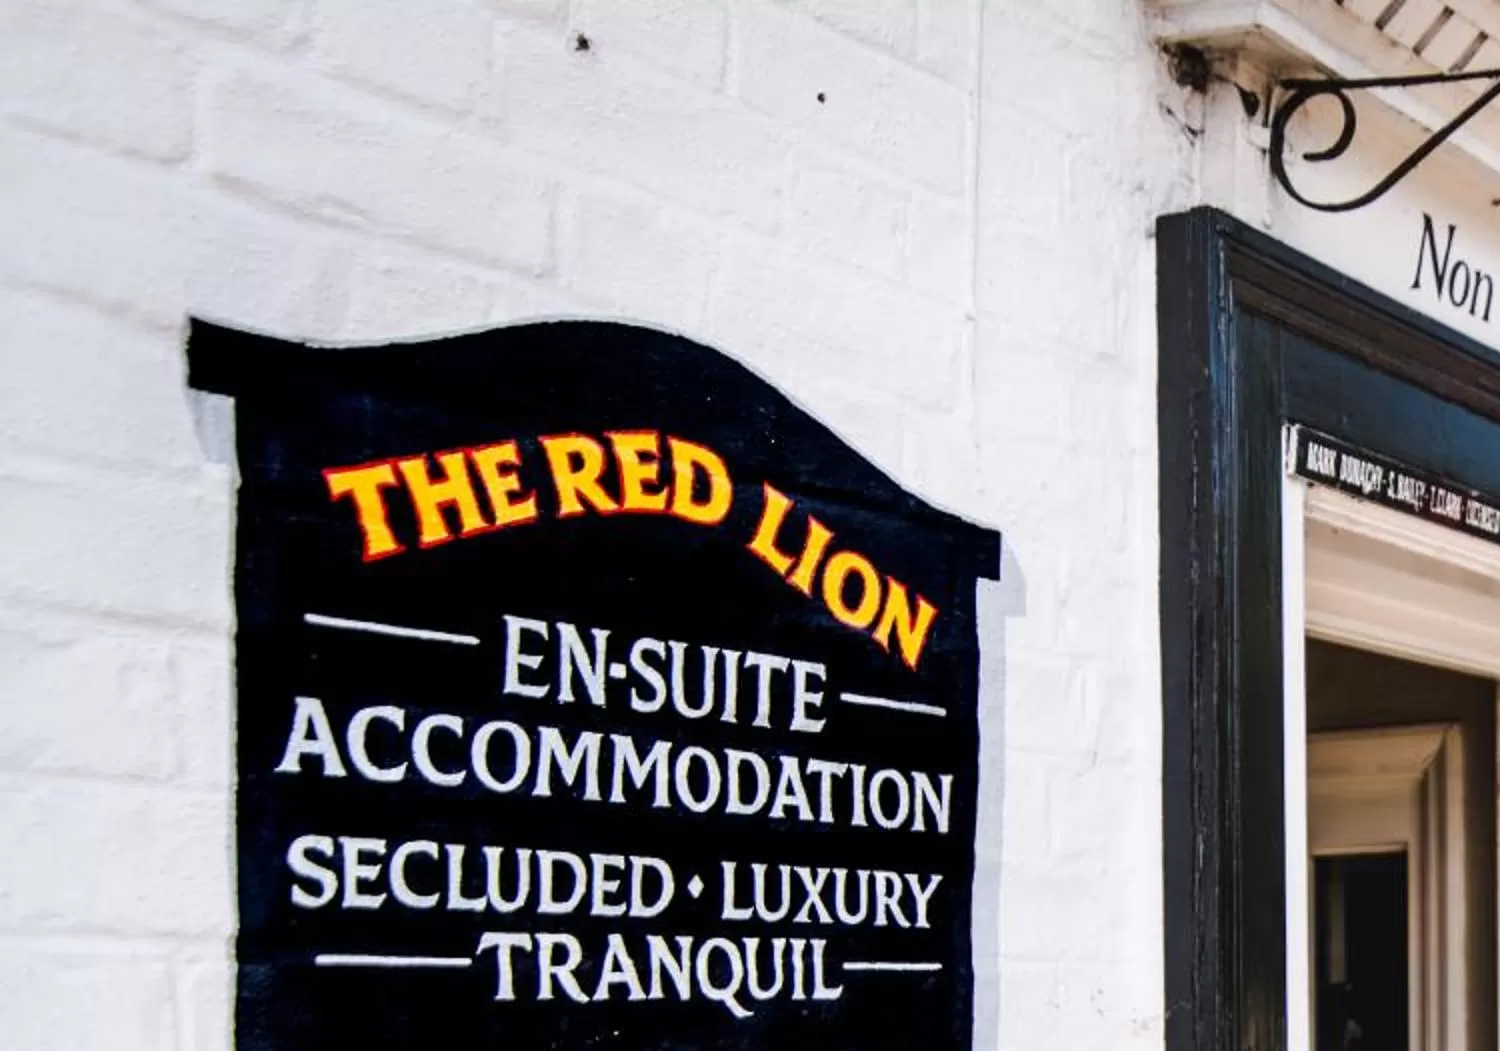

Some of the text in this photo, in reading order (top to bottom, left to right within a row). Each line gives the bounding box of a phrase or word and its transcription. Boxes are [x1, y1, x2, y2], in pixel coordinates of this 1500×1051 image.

[1410, 213, 1492, 321] Non
[322, 430, 938, 671] THE RED LION
[503, 615, 826, 732] EN-SUITE
[274, 697, 953, 833] ACCOMMODATION
[286, 835, 942, 928] SECLUDED LUXURY
[476, 932, 843, 1018] TRANQUIL
